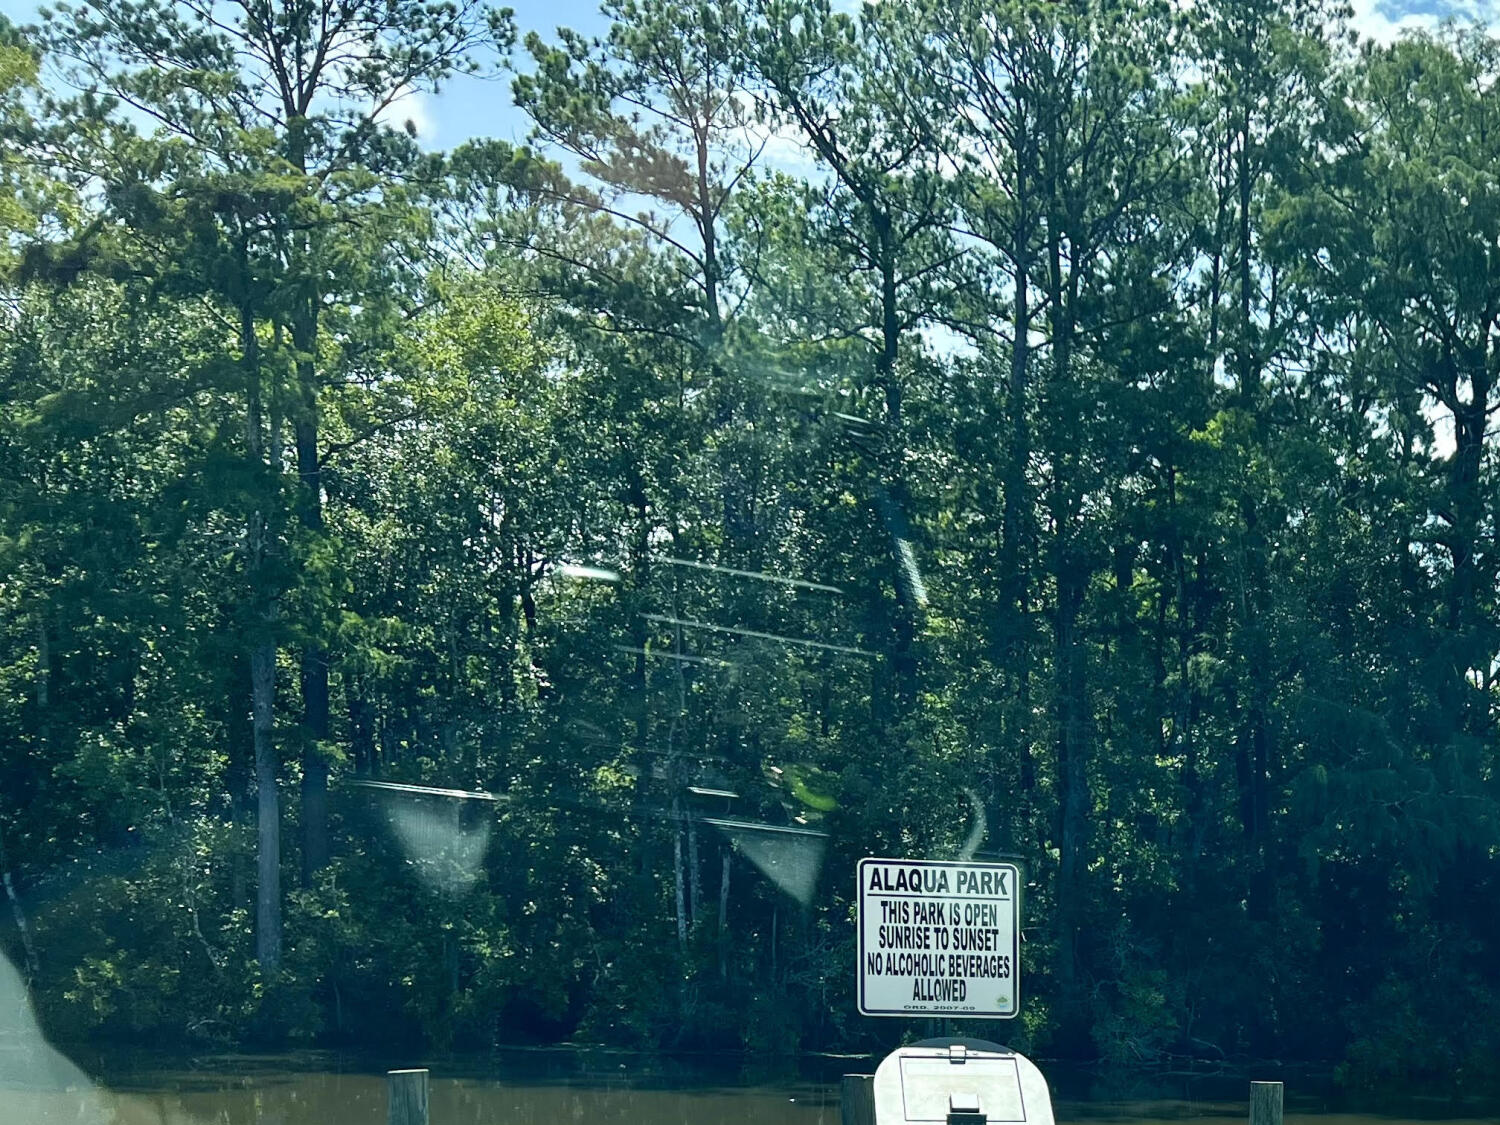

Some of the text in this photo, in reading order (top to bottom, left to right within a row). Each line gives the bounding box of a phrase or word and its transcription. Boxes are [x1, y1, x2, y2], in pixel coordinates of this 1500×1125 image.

[869, 868, 1008, 895] ALAQUA PARK
[881, 901, 997, 927] THIS PARK IS OPEN
[879, 926, 999, 951] SUNRISE TO SUNSET
[867, 952, 1010, 978] NO ALCOHOLIC BEVERAGES
[912, 978, 966, 1002] ALLOWED
